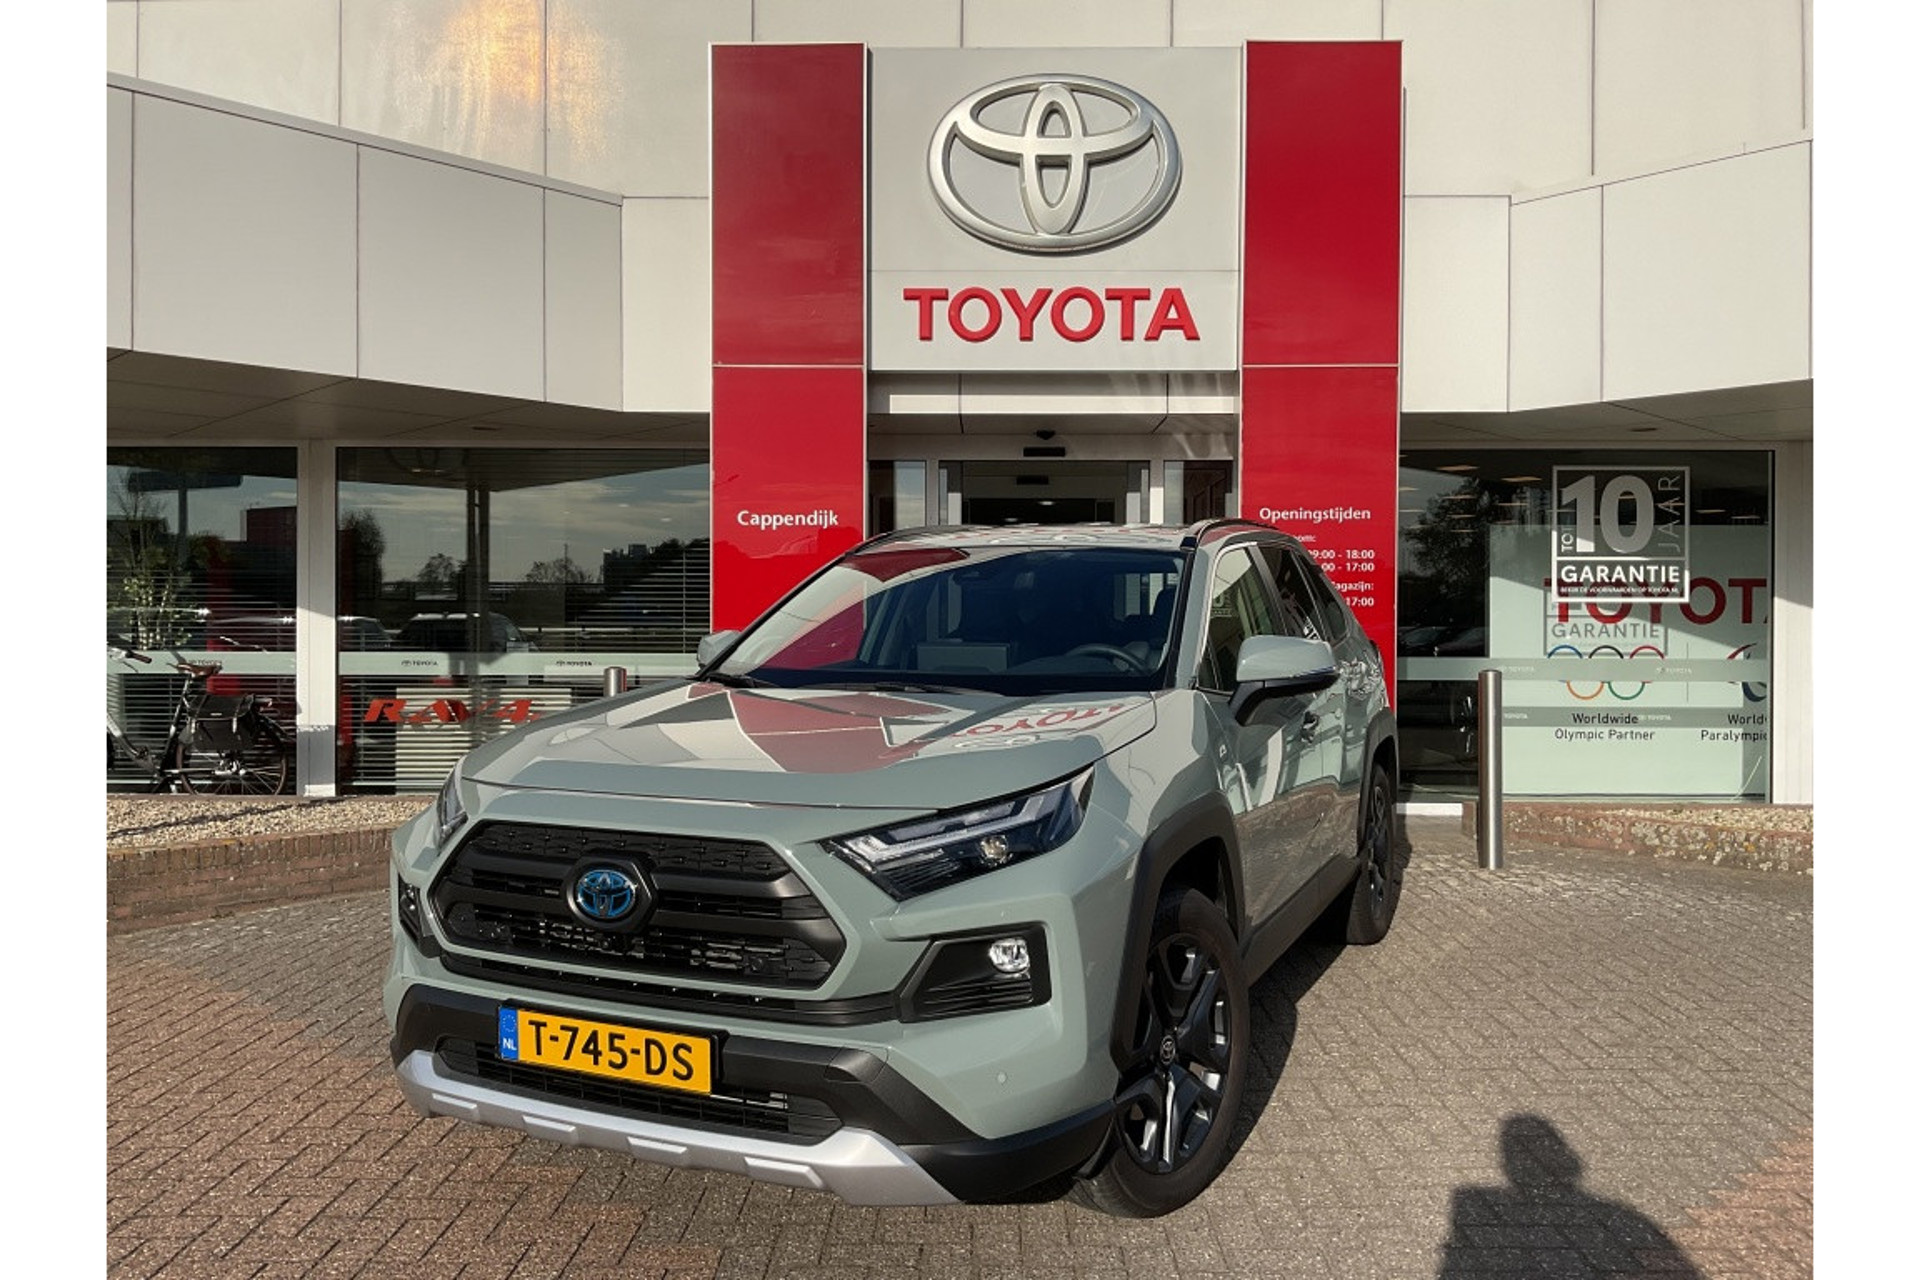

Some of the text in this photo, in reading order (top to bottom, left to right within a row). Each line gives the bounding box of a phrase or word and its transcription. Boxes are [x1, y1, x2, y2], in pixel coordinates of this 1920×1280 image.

[903, 286, 1200, 343] TOYOTA
[737, 509, 839, 531] Cappendijk
[1259, 507, 1371, 524] Openingstijden
[1560, 474, 1655, 553] 10
[1658, 475, 1681, 552] JAAR
[1345, 549, 1375, 559] 18:00
[1345, 562, 1375, 572] 17:00
[1560, 564, 1680, 583] GARANTIE
[1345, 597, 1375, 607] 17:00
[1544, 577, 1768, 625] TOYOT
[1551, 623, 1660, 638] GARANTIE
[1572, 713, 1639, 724] Worldwide
[1728, 713, 1767, 724] World
[1554, 729, 1655, 742] Olympic Partner
[503, 1037, 517, 1050] NL
[528, 1019, 694, 1081] T-745-DS
